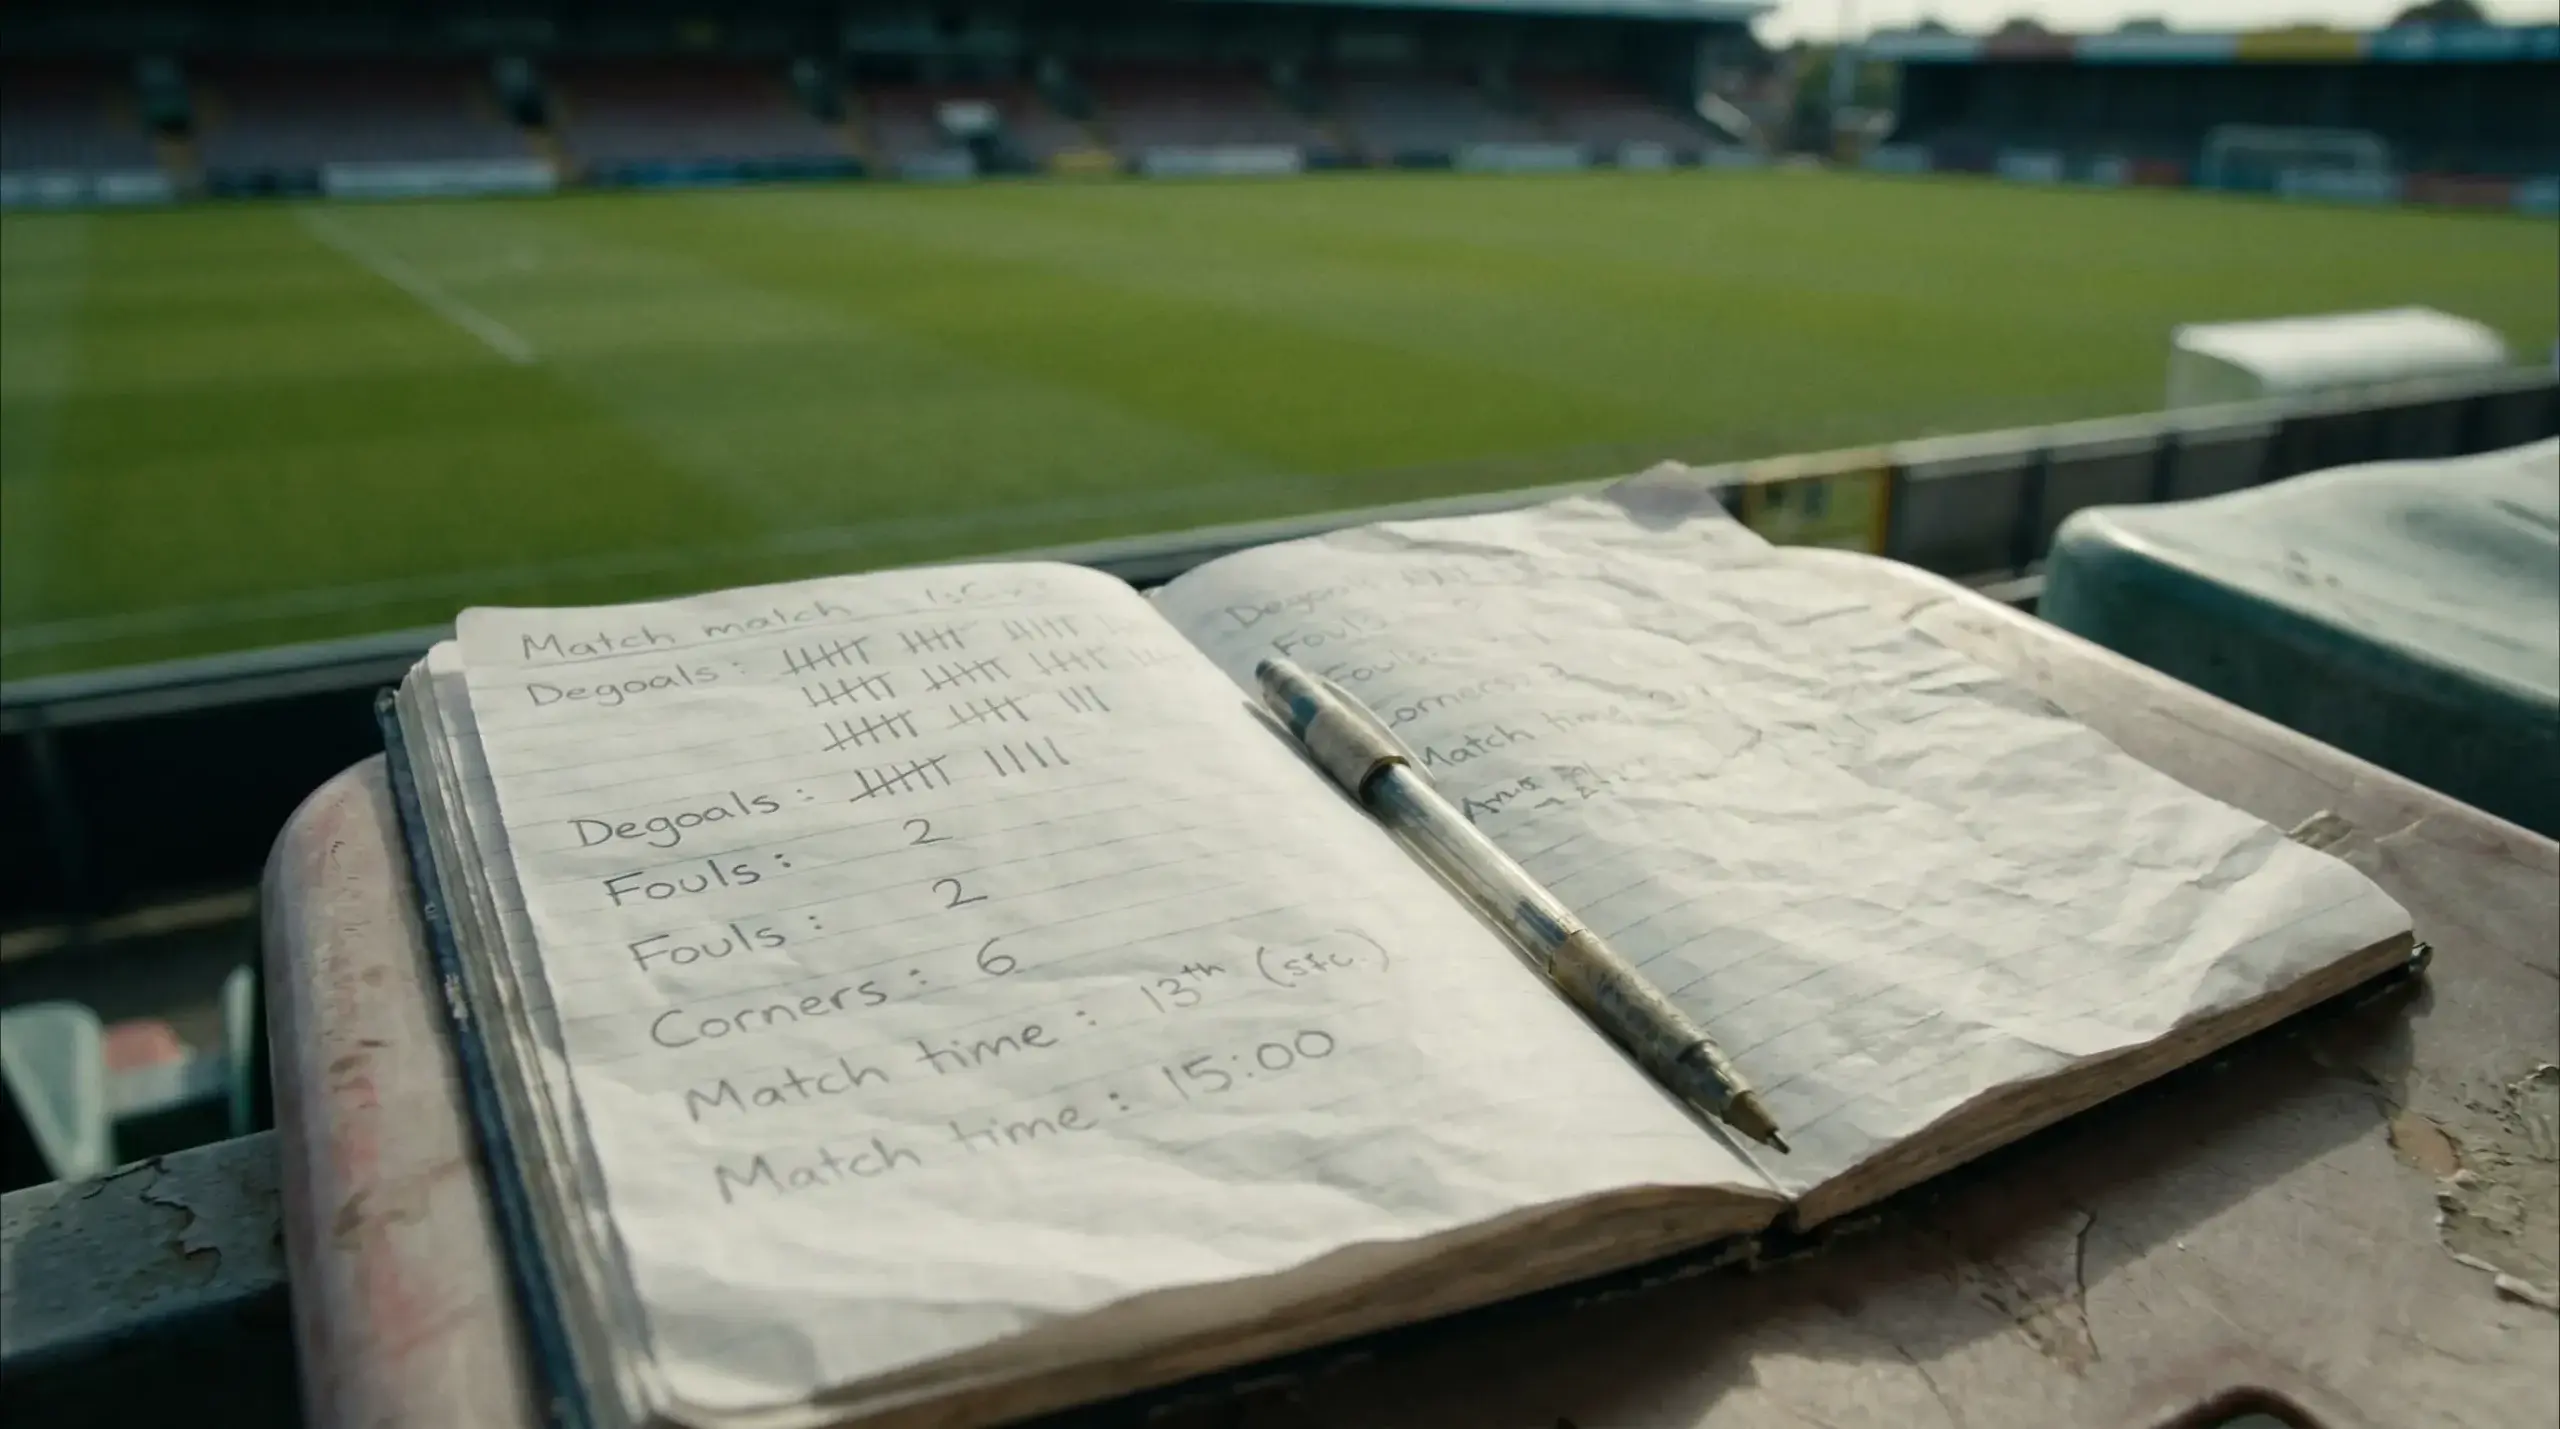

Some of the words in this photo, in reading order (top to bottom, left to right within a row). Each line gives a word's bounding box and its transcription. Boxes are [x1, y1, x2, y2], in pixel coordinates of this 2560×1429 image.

[520, 624, 676, 661] Match
[702, 600, 853, 638] match
[902, 817, 954, 847] 2
[932, 877, 989, 909] 2
[976, 937, 1018, 976] 6
[684, 1057, 890, 1123] Match
[712, 1137, 922, 1204] Match
[1160, 1028, 1336, 1102] 15:00
